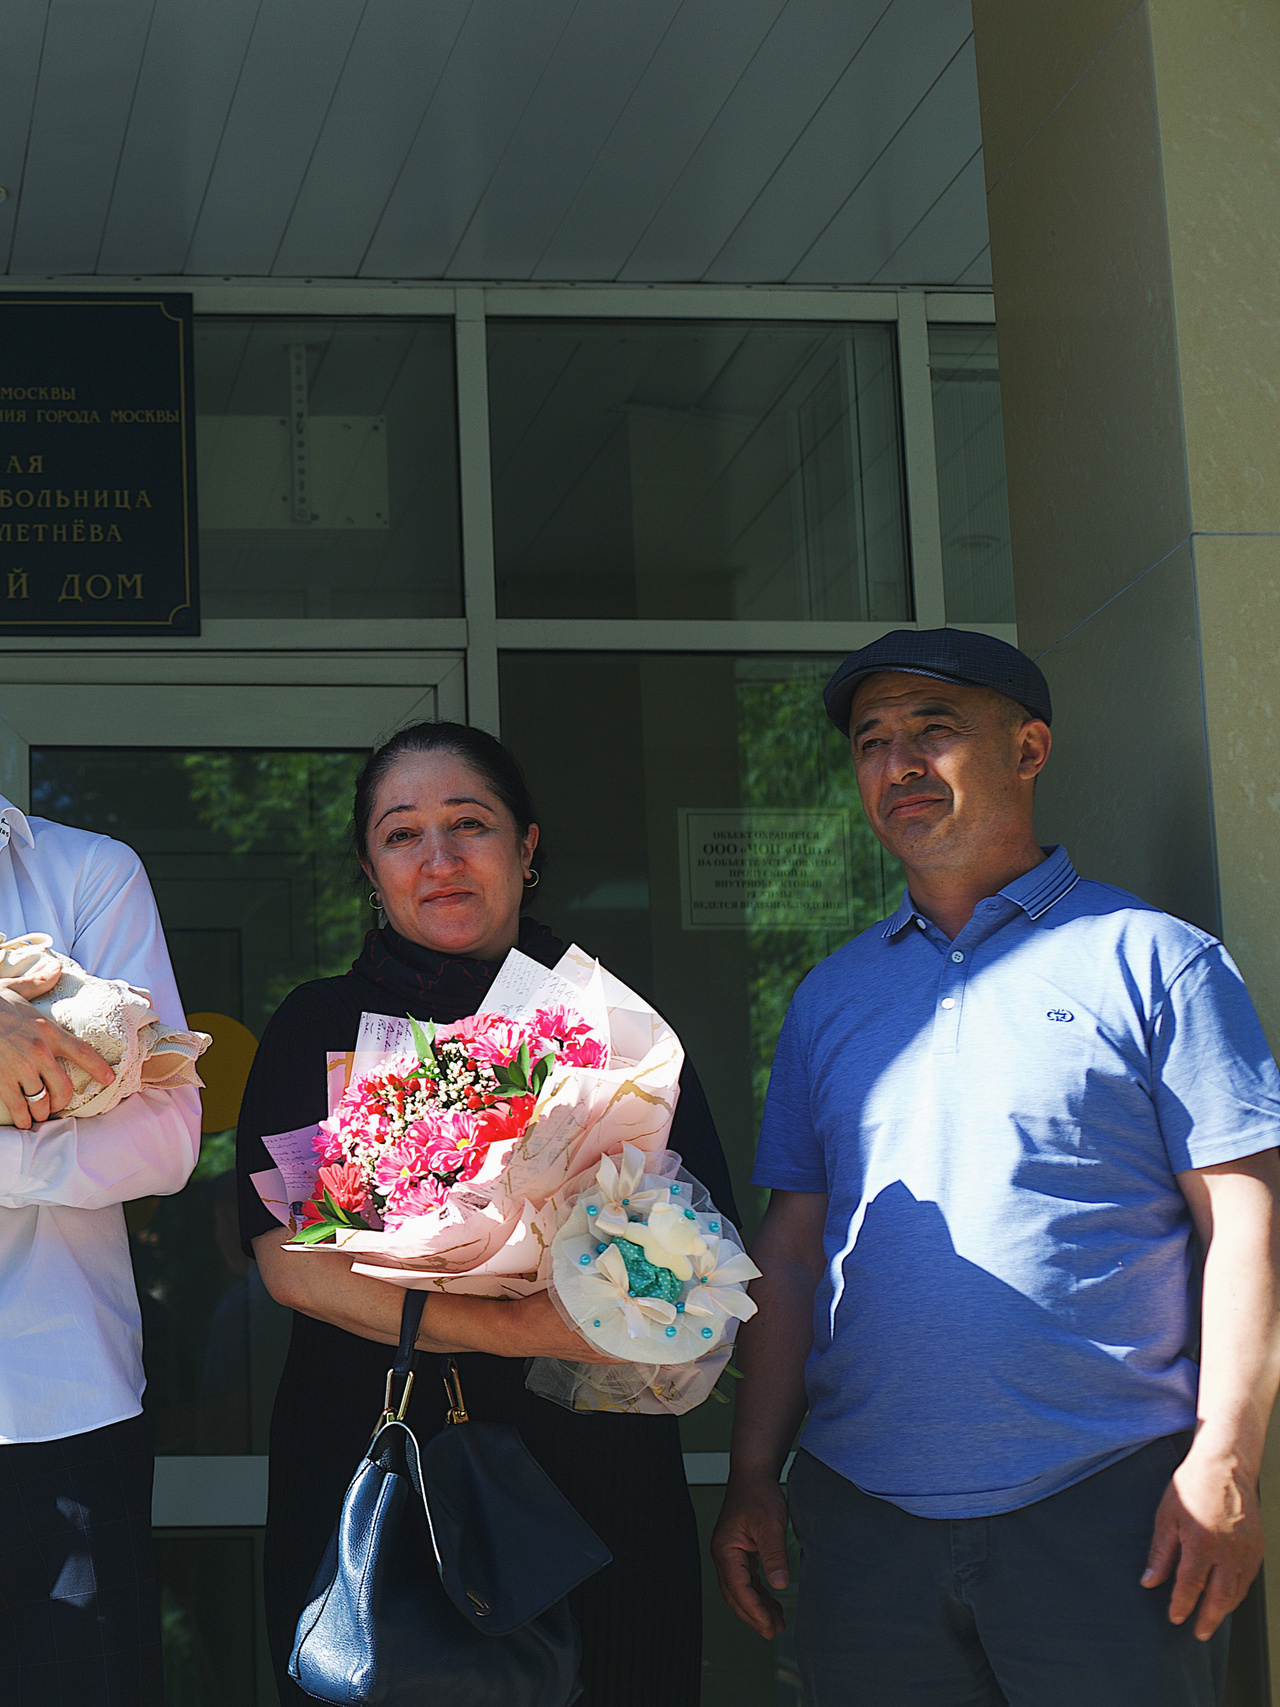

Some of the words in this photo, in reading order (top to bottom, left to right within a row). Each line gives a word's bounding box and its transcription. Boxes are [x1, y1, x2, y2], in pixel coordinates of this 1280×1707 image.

[0, 387, 76, 401] МОСКВЫ
[37, 409, 101, 424] ГОРОДА
[111, 410, 180, 424] МОСКВЫ
[57, 573, 144, 603] ДОМ
[702, 842, 738, 856] ООО
